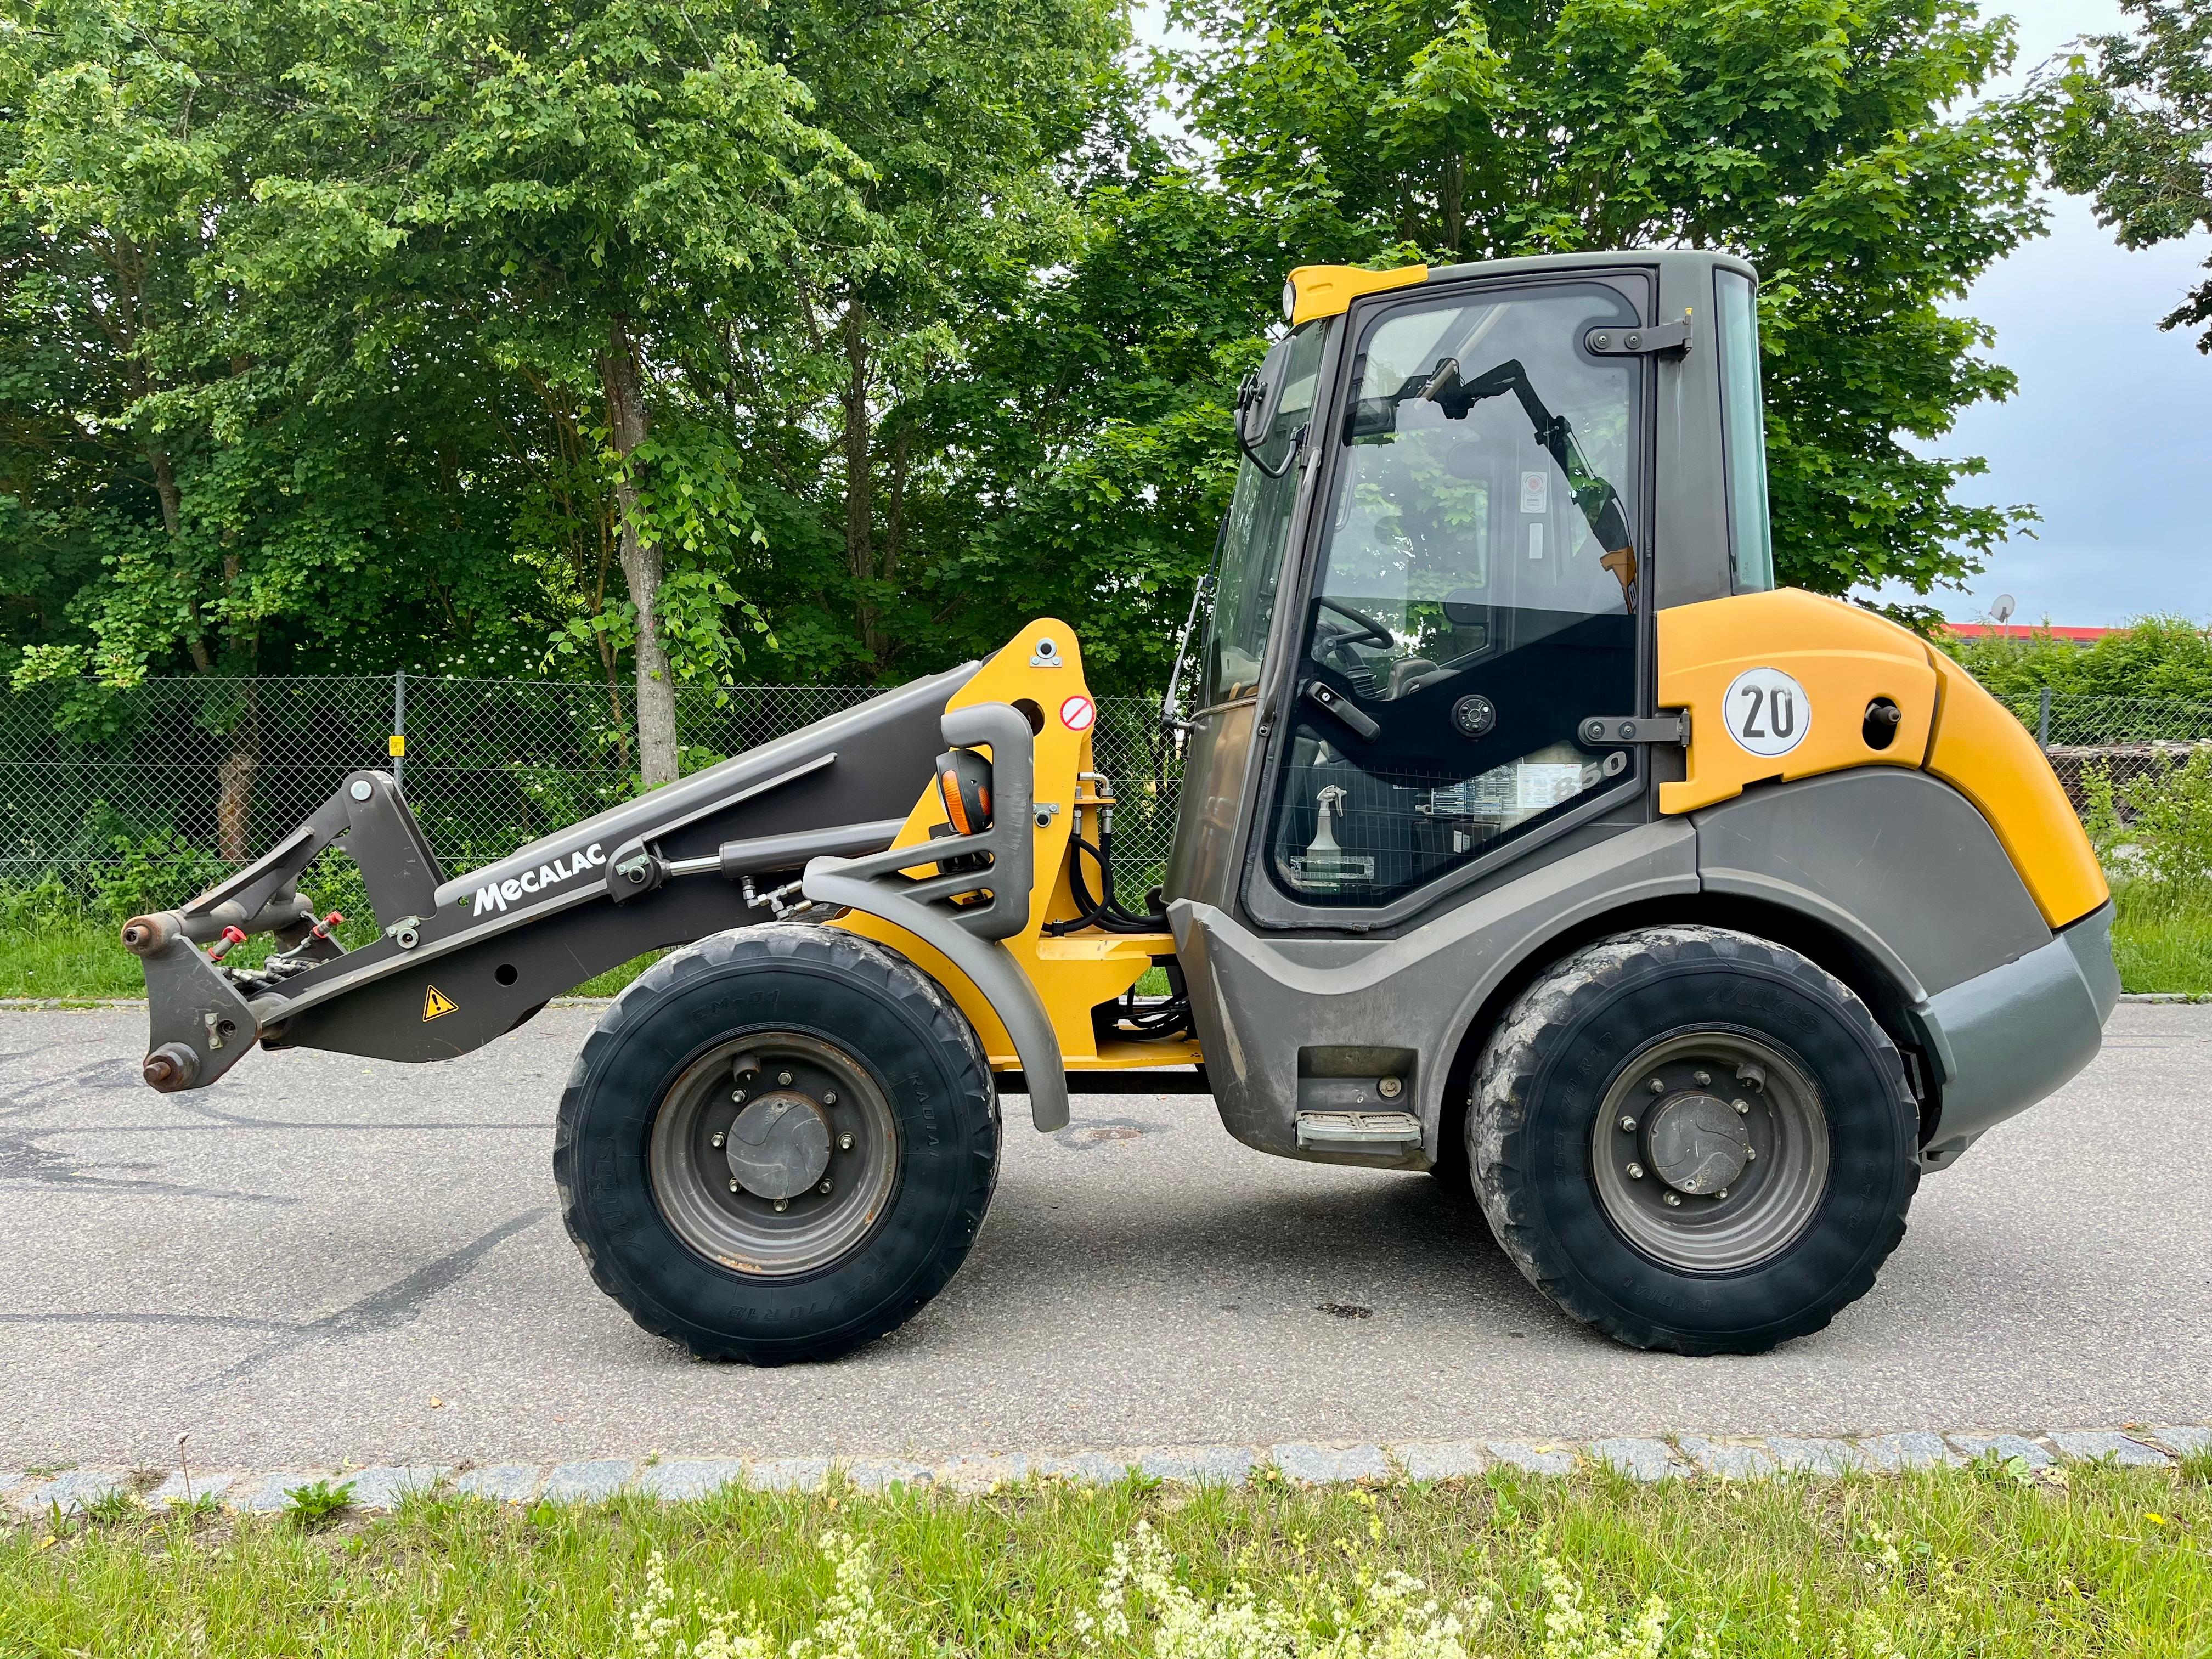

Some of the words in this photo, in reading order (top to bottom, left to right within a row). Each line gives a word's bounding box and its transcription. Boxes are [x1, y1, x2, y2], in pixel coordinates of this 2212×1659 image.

[1741, 684, 1794, 738] 20
[1553, 751, 1627, 802] 850
[691, 989, 781, 1023] EM-01
[906, 1071, 940, 1159] RADIAL
[1623, 1274, 1712, 1313] RADIAL
